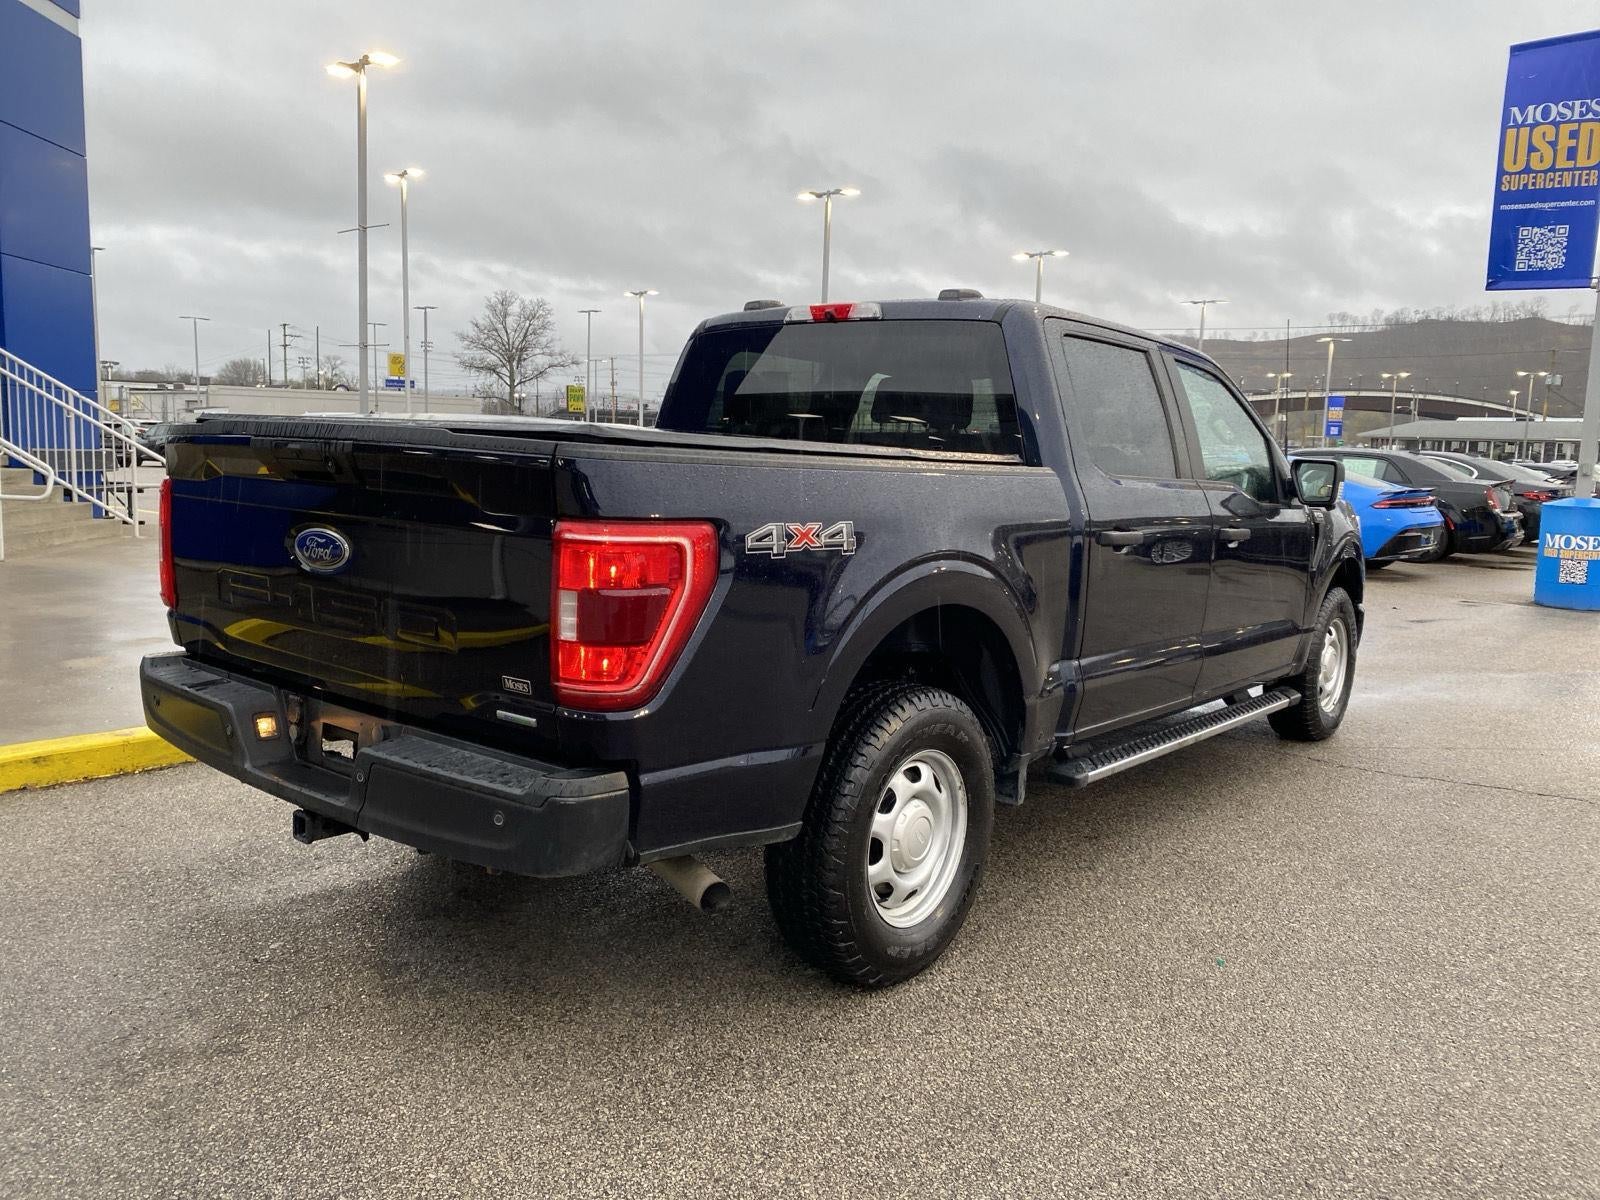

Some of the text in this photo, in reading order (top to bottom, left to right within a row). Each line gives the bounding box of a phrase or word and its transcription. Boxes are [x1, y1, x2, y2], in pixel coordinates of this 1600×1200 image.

[1503, 122, 1600, 172] USED
[1501, 170, 1598, 191] SUPERCENTER
[1500, 199, 1595, 211] mosesusedsupercenter.com
[303, 535, 334, 561] Ford
[1544, 533, 1600, 551] MOSE
